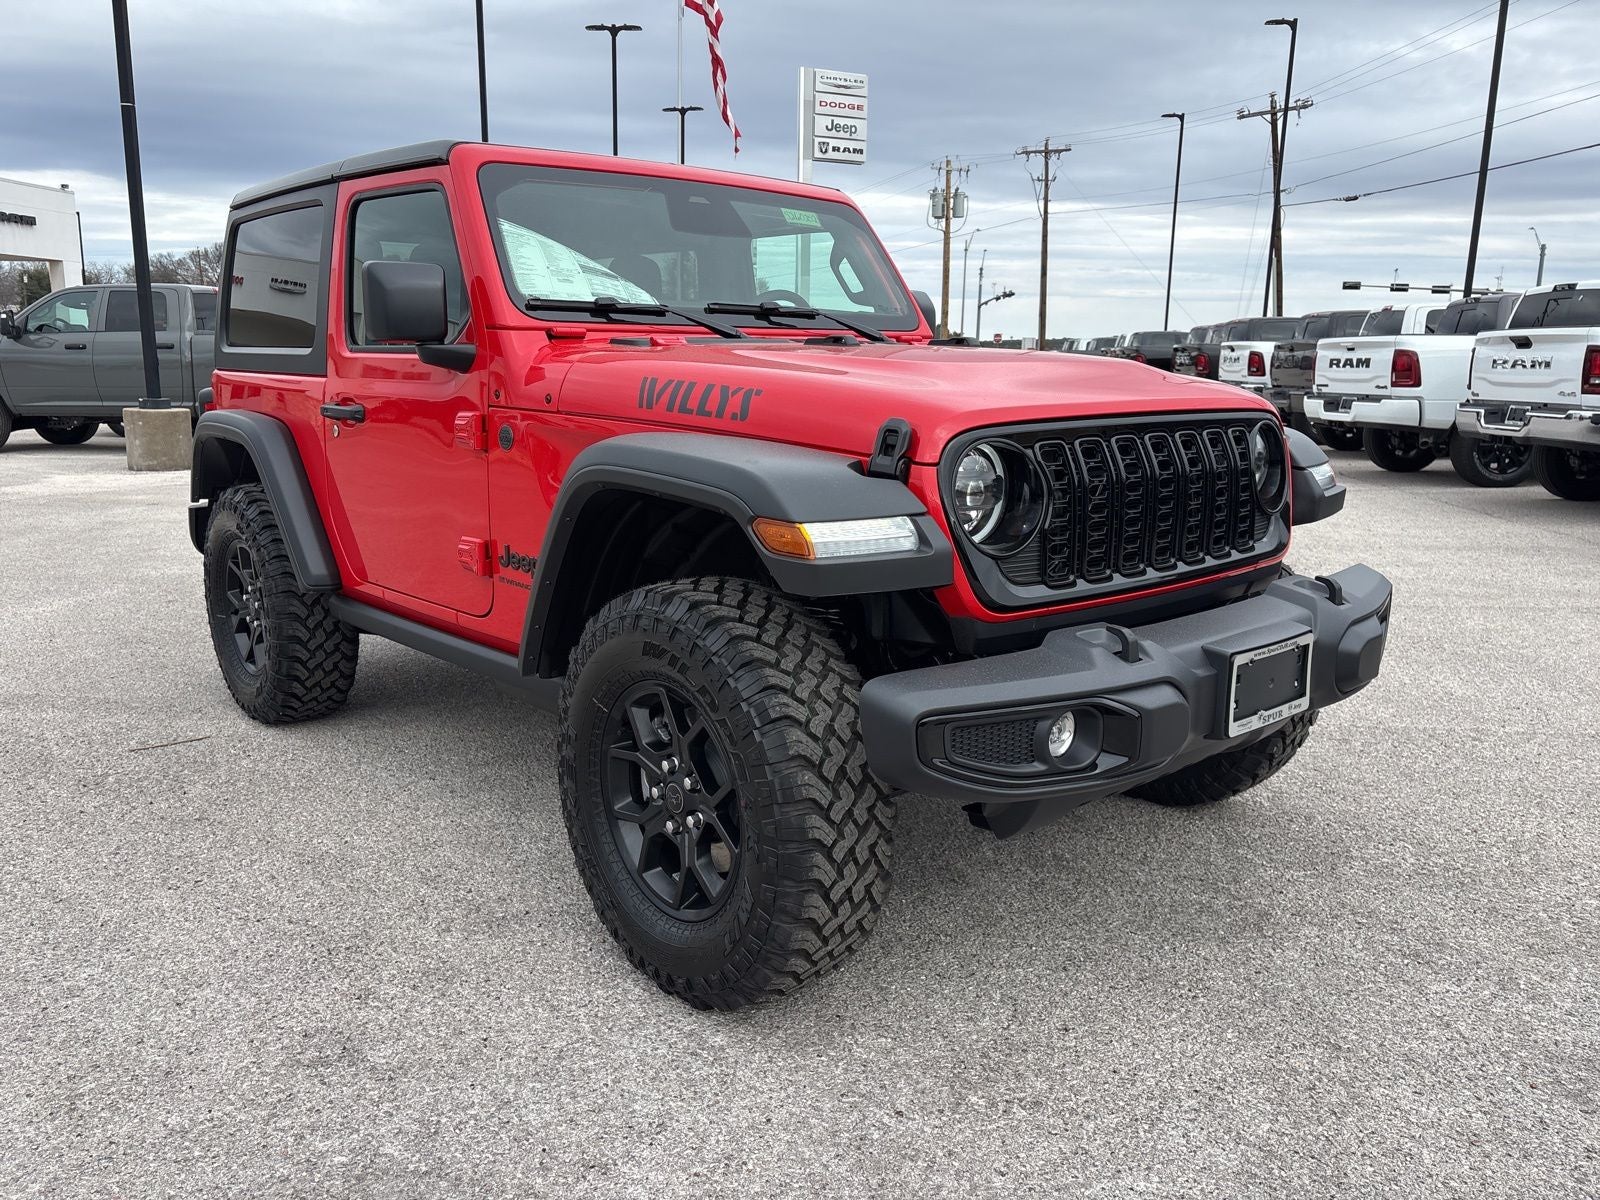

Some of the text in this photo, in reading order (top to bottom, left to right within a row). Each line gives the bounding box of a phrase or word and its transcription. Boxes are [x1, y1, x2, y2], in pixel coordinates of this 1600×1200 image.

[820, 75, 865, 84] CHRYSLER
[819, 100, 865, 111] DODGE
[825, 119, 858, 136] Jeep
[831, 145, 864, 155] RAM
[1329, 358, 1371, 368] RAM
[1491, 357, 1553, 369] RAM
[638, 376, 763, 422] WILLYS
[1262, 710, 1283, 724] SPUR
